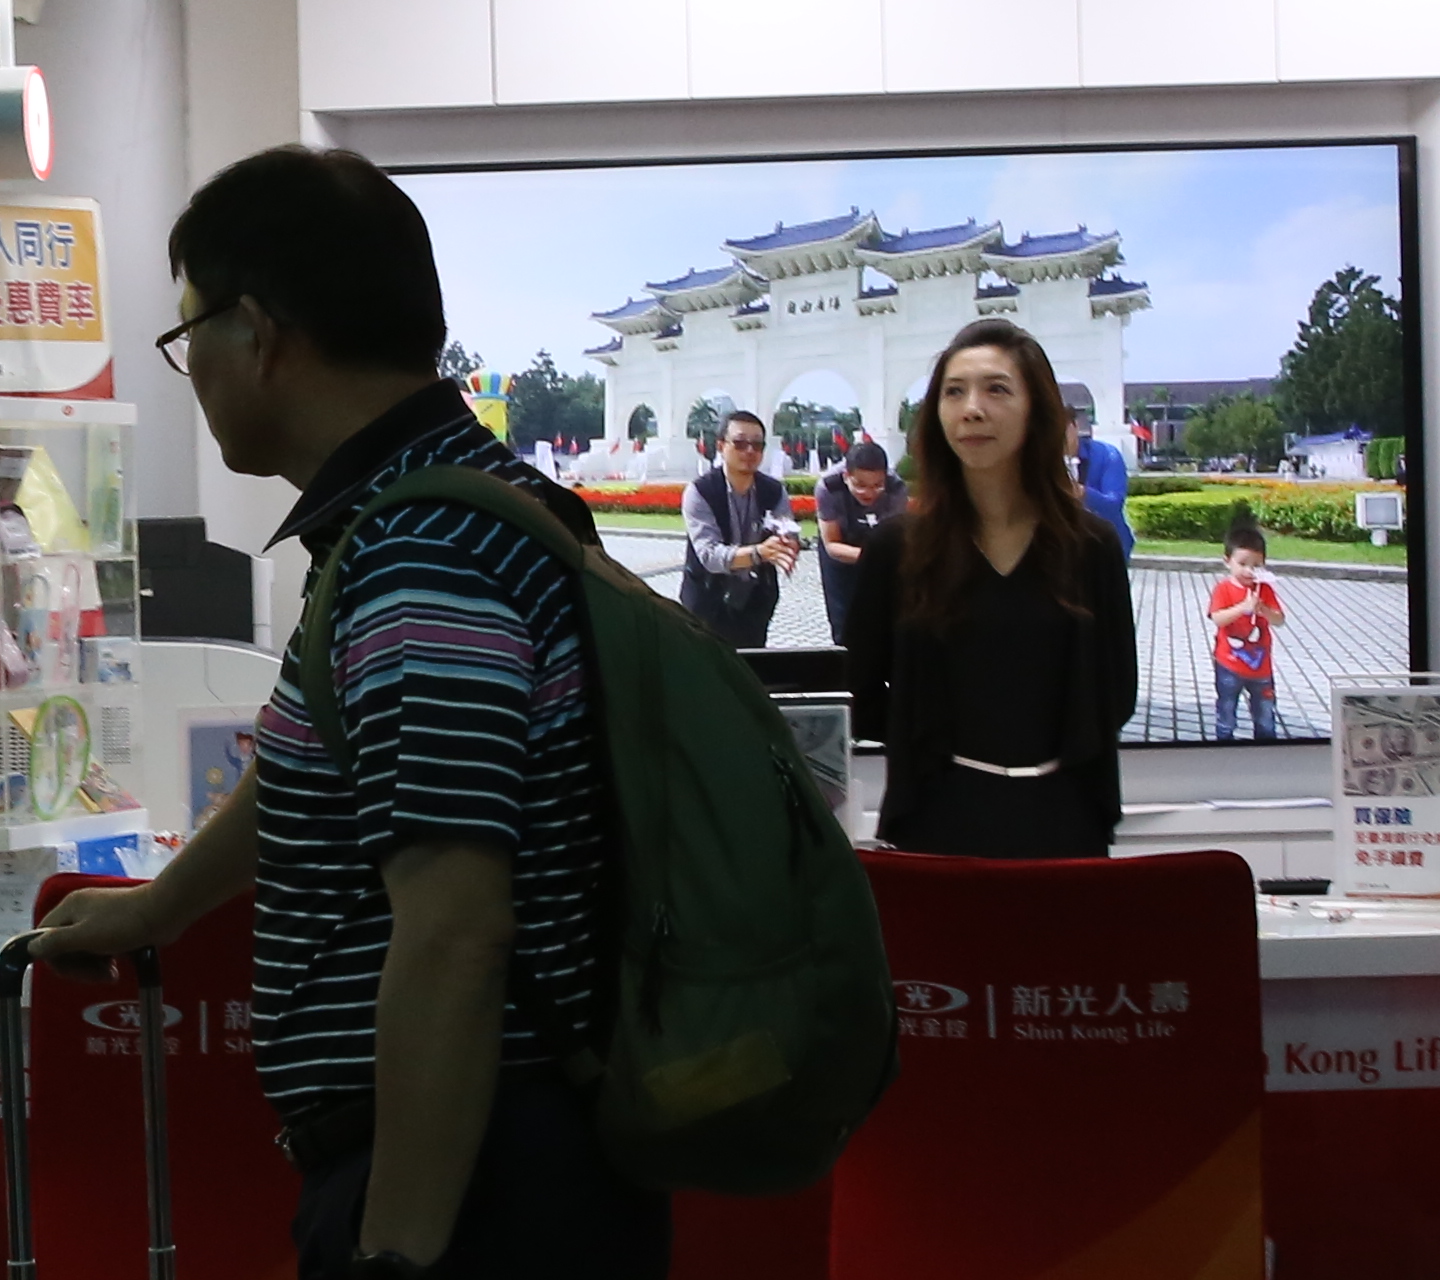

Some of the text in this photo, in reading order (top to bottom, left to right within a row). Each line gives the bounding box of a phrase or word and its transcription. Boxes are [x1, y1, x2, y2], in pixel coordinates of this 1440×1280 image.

[1010, 980, 1192, 1018] 新光人壽
[898, 1016, 969, 1040] 光金控
[1012, 1020, 1178, 1045] Shin Kong Life
[1285, 1041, 1382, 1085] Kong
